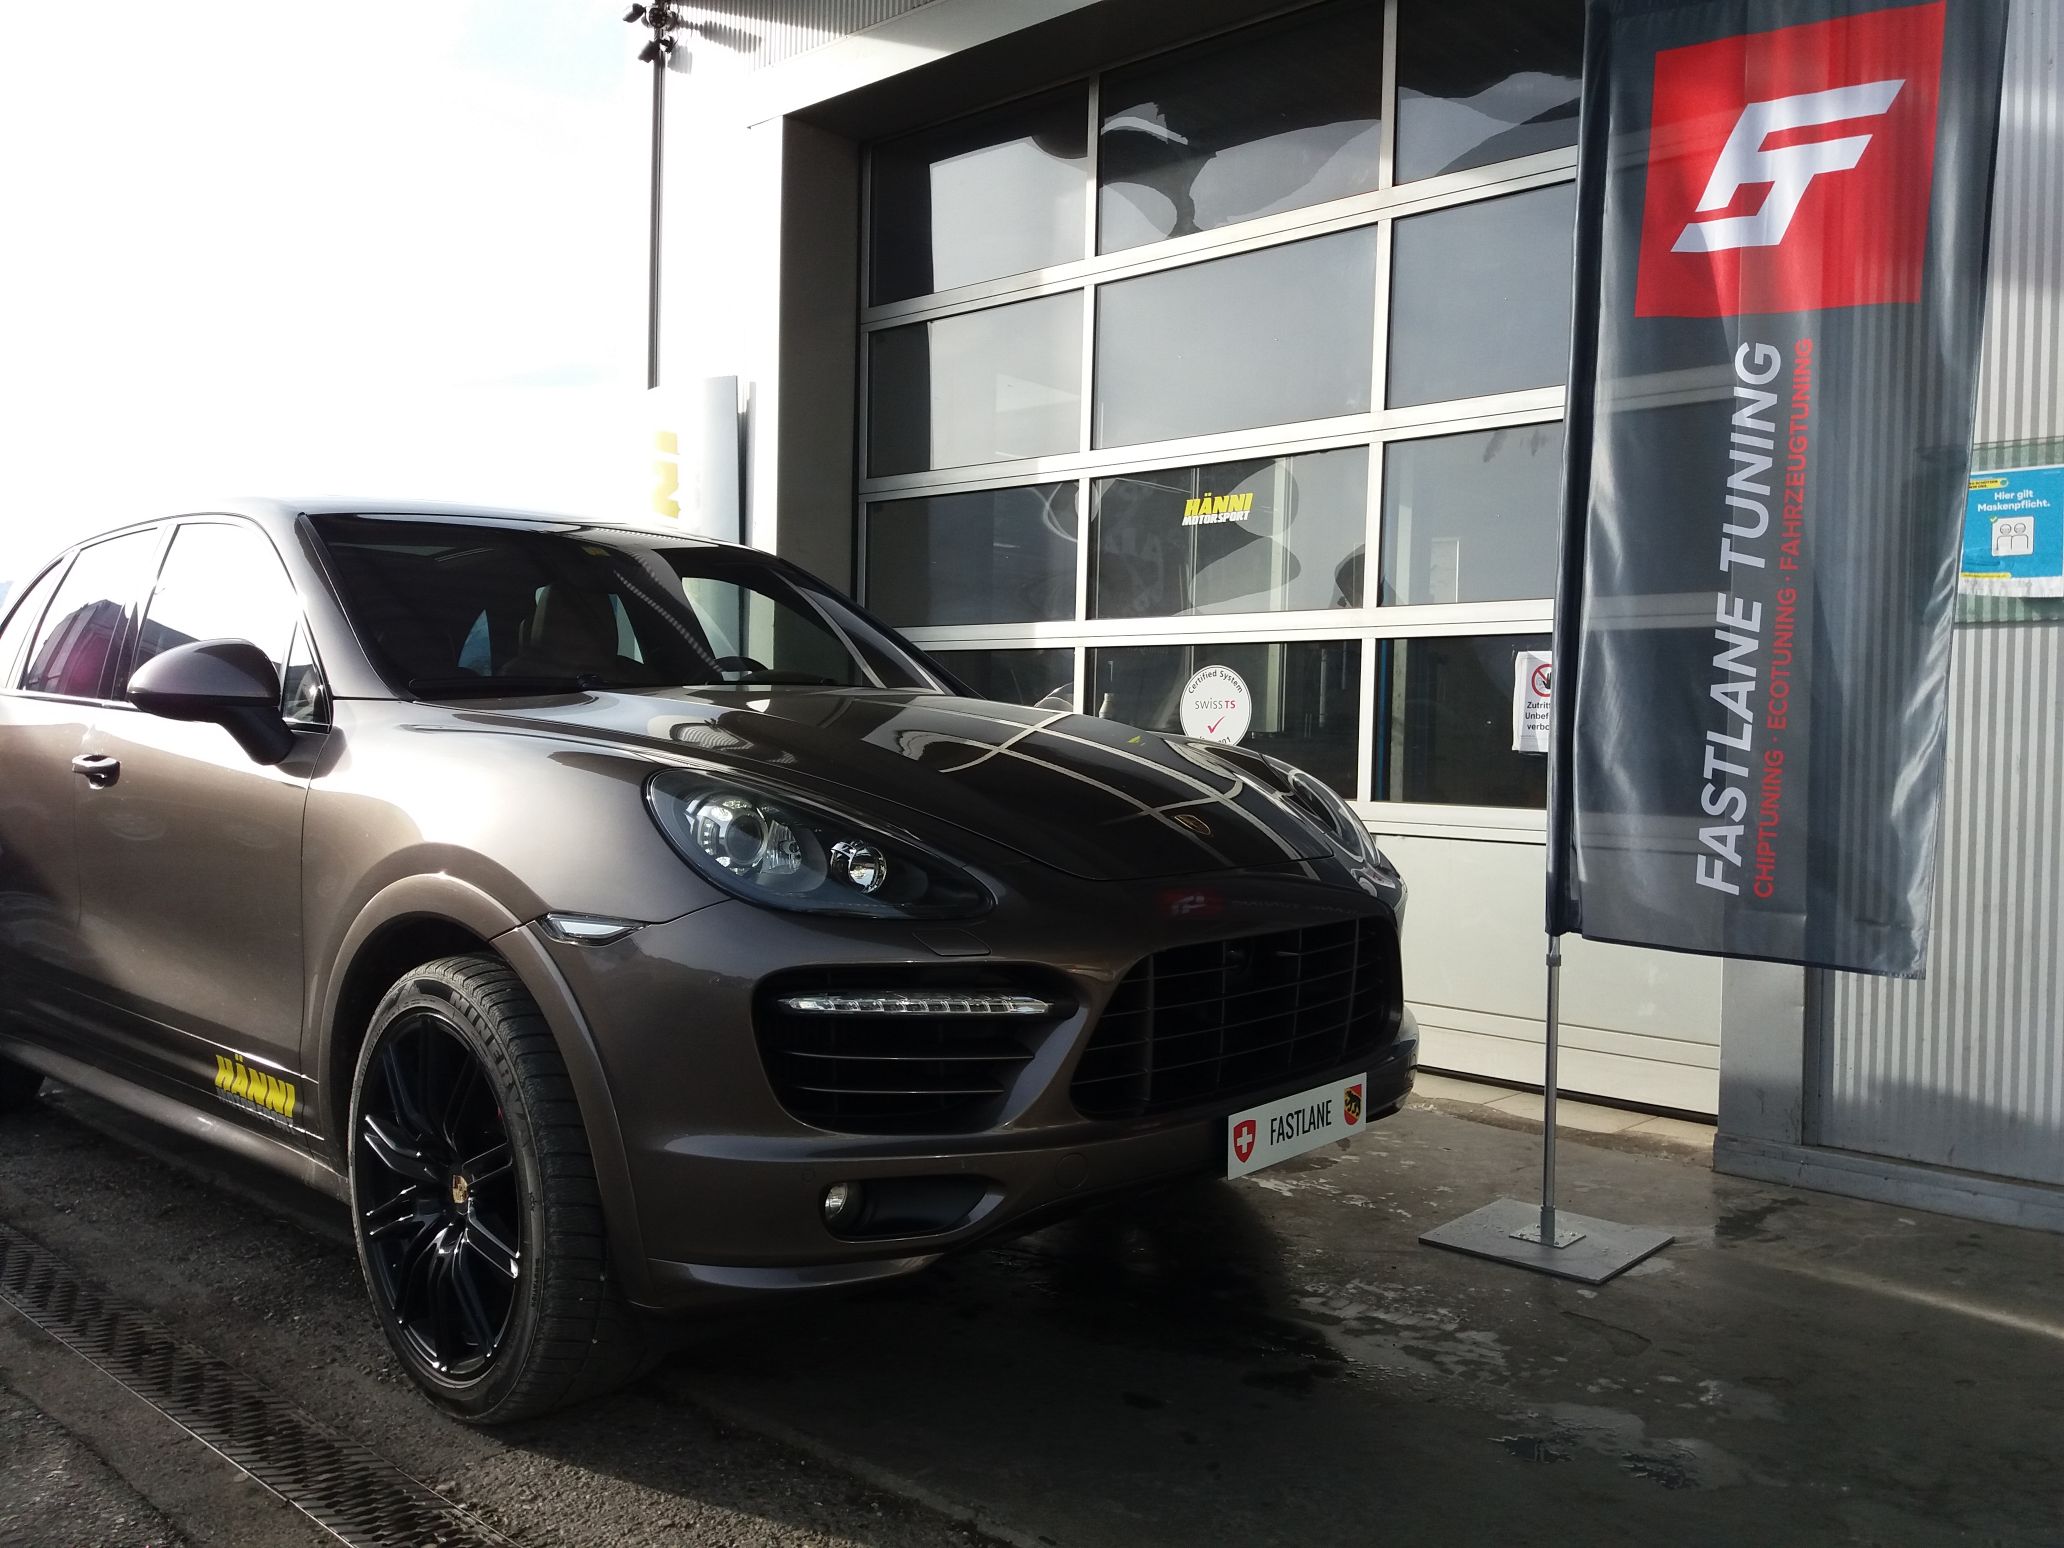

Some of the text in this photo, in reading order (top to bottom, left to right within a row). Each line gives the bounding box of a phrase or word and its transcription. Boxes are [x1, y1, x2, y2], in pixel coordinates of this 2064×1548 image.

[1184, 492, 1254, 517] HÄNNI
[1977, 499, 2051, 512] Maskenpflicht.
[1994, 489, 2034, 501] Hier gilt
[1182, 510, 1251, 526] MOTORSPORT
[1696, 340, 1783, 897] FASTLANE TUNING
[1754, 337, 1815, 898] CHIPTUNING ECOTUNING FAHRZEUGTUNING
[1188, 669, 1243, 694] Certified System
[1525, 711, 1549, 720] Unbef
[215, 1053, 296, 1118] HÄNNI
[1270, 1099, 1333, 1146] FASTLANE
